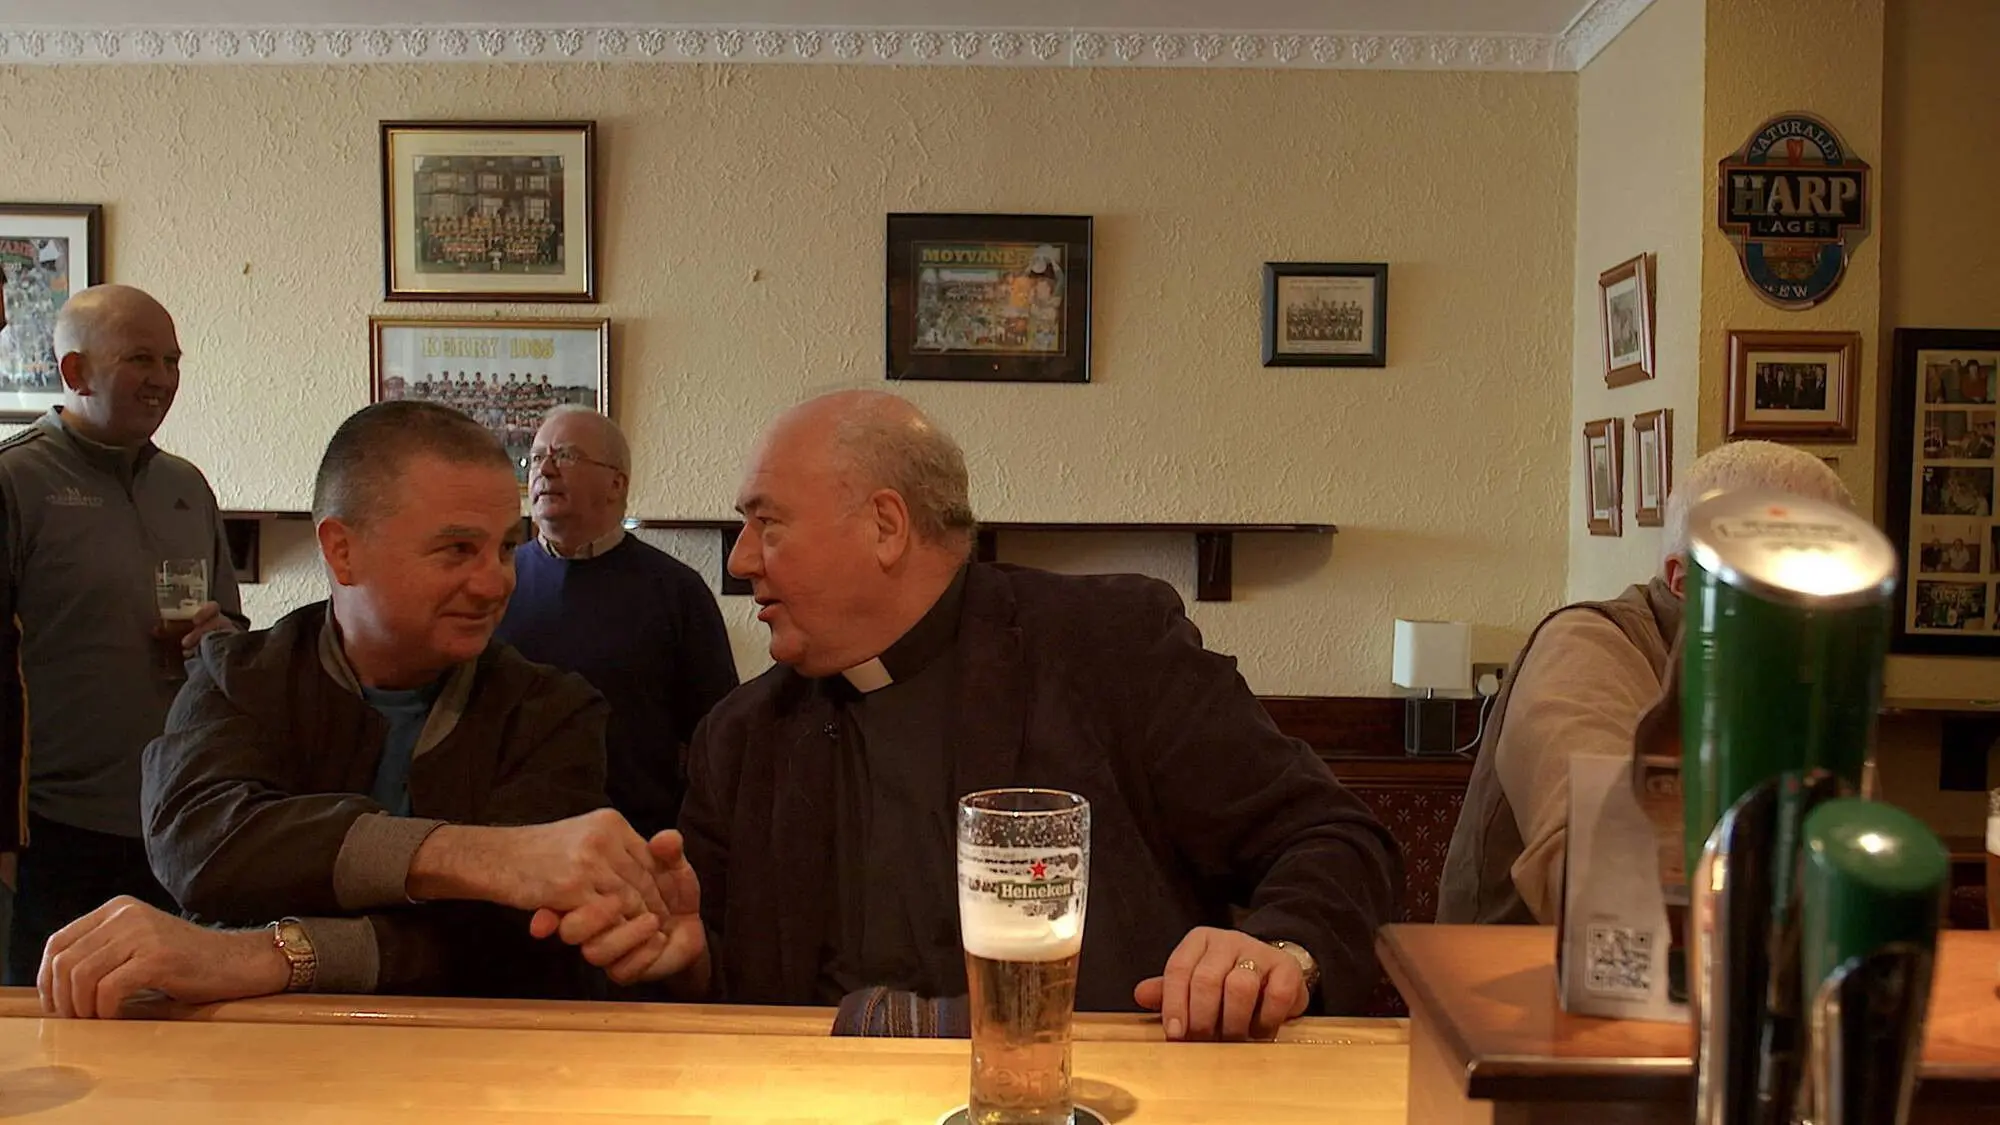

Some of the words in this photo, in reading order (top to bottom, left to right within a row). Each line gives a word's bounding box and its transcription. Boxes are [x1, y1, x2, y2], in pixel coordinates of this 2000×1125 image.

[1732, 175, 1857, 217] HARP
[422, 336, 500, 359] KERRY
[1001, 882, 1071, 898] Heineken
